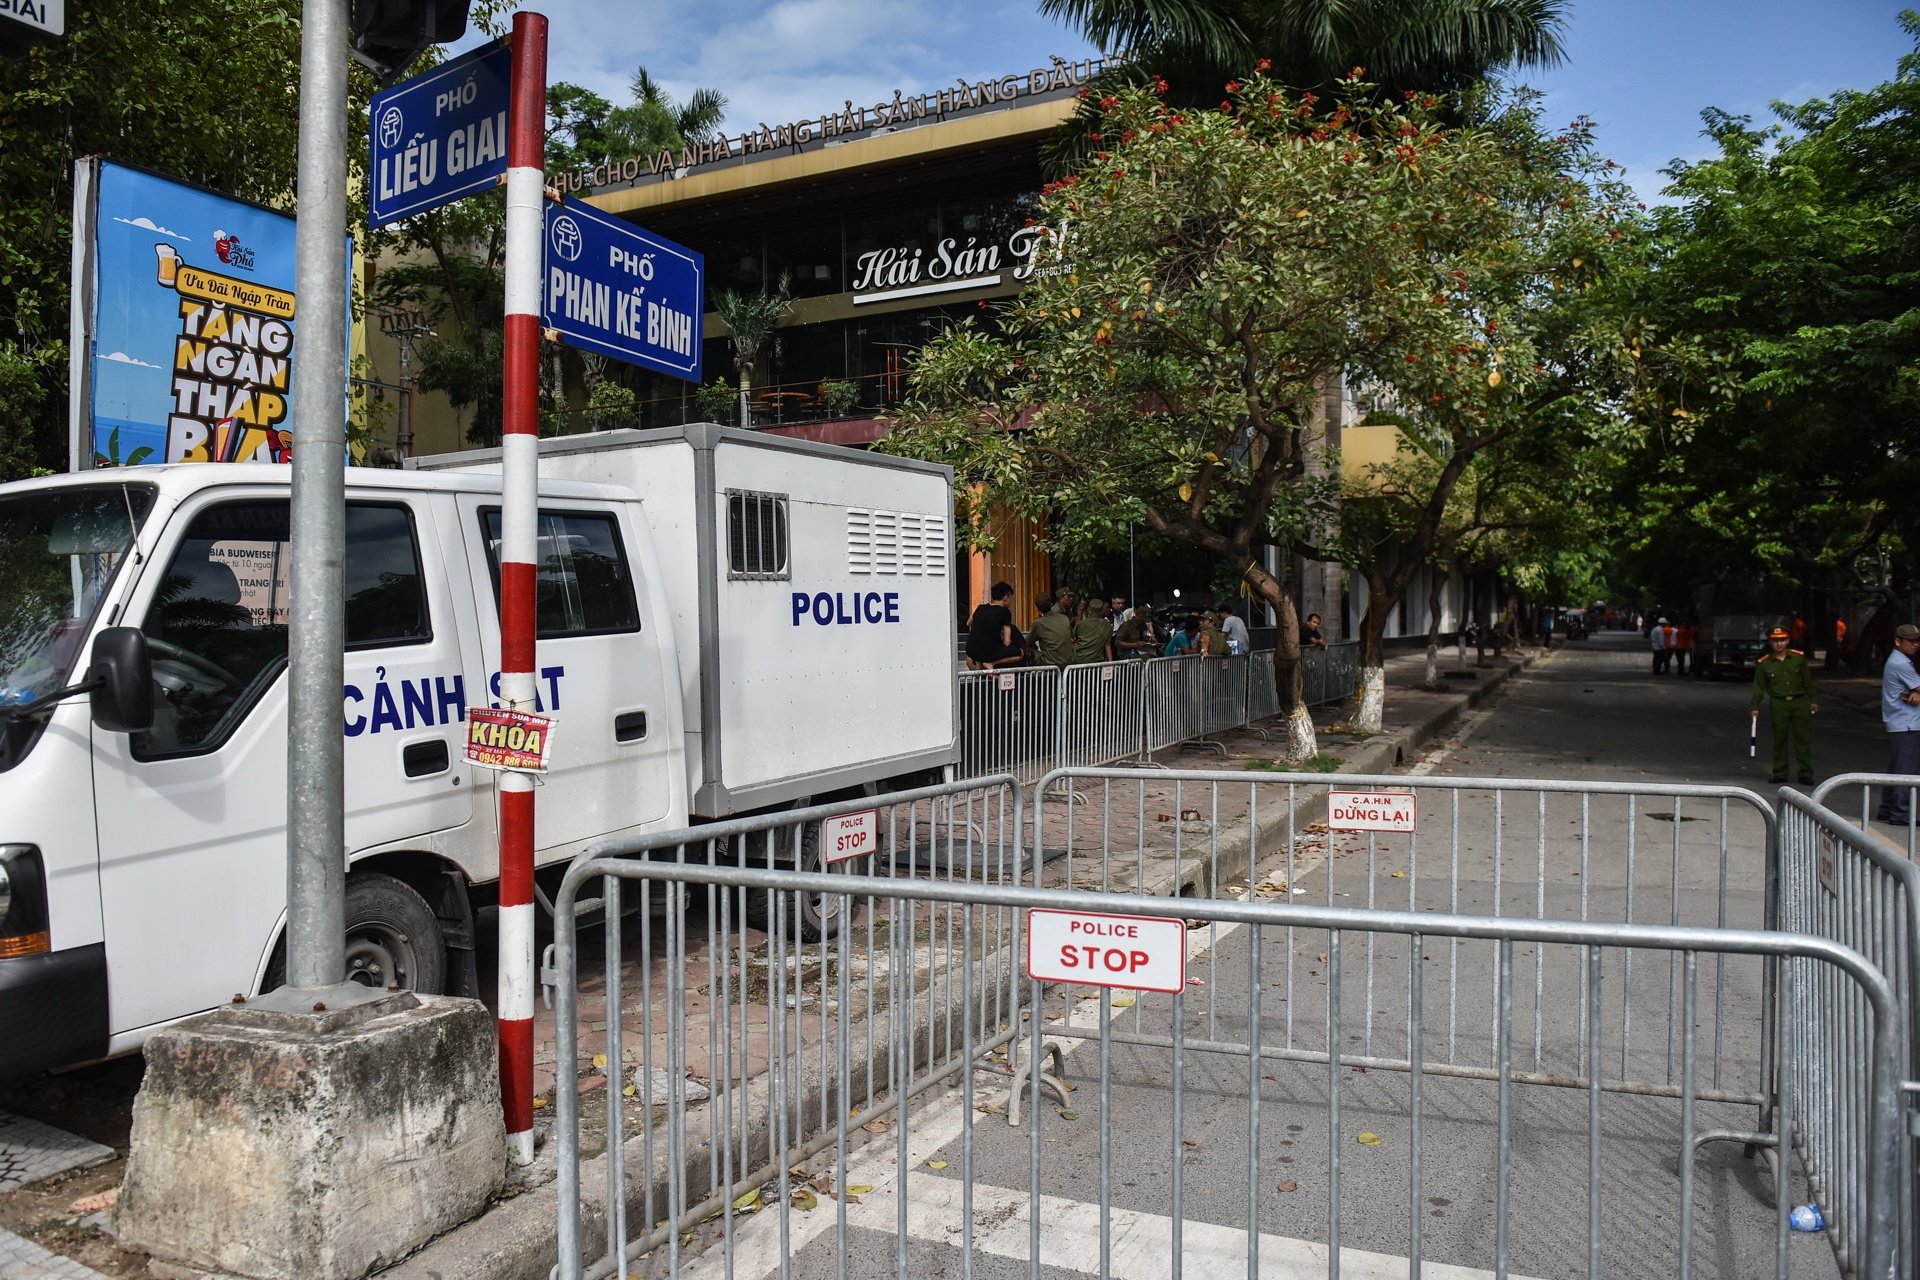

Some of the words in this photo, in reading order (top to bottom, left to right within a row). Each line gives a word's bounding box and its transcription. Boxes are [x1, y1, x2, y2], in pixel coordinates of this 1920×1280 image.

[0, 0, 45, 24] IAI
[435, 70, 478, 117] PHỐ
[593, 155, 641, 187] CHỢ
[647, 145, 674, 174] VÀ
[681, 131, 732, 168] NHÀ
[740, 119, 812, 156] HÀNG
[820, 100, 864, 137] HẢI
[873, 88, 927, 127] SẢN
[936, 74, 1019, 114] HÀNG
[1028, 54, 1091, 95] ĐẦU
[380, 132, 438, 201] LIỄU
[446, 111, 506, 177] GIAI
[609, 245, 656, 281] PHỐ
[852, 247, 922, 290] Hải
[928, 236, 1001, 279] Sản
[184, 273, 205, 290] Ưu
[207, 279, 229, 296] Đãi
[231, 285, 261, 307] Ngập
[264, 293, 291, 311] Tràn
[182, 300, 289, 352] TẶNG
[550, 266, 610, 331] PHAN
[616, 286, 645, 340] KẾ
[647, 297, 692, 357] BÍNH
[176, 338, 287, 389] NGÀN
[174, 378, 283, 426] THÁP
[167, 416, 272, 464] BIA
[210, 548, 225, 557] BIA
[242, 559, 252, 568] 10
[239, 578, 270, 588] TRANG
[792, 592, 900, 626] POLICE
[343, 665, 466, 737] CẢNH
[471, 720, 541, 755] KHÓA
[479, 752, 502, 765] 0942
[840, 817, 863, 829] POLICE
[1334, 805, 1379, 821] DỪNG
[1382, 810, 1409, 824] LẠI
[837, 831, 867, 851] STOP
[1070, 921, 1138, 938] POLICE
[1060, 944, 1149, 973] STOP
